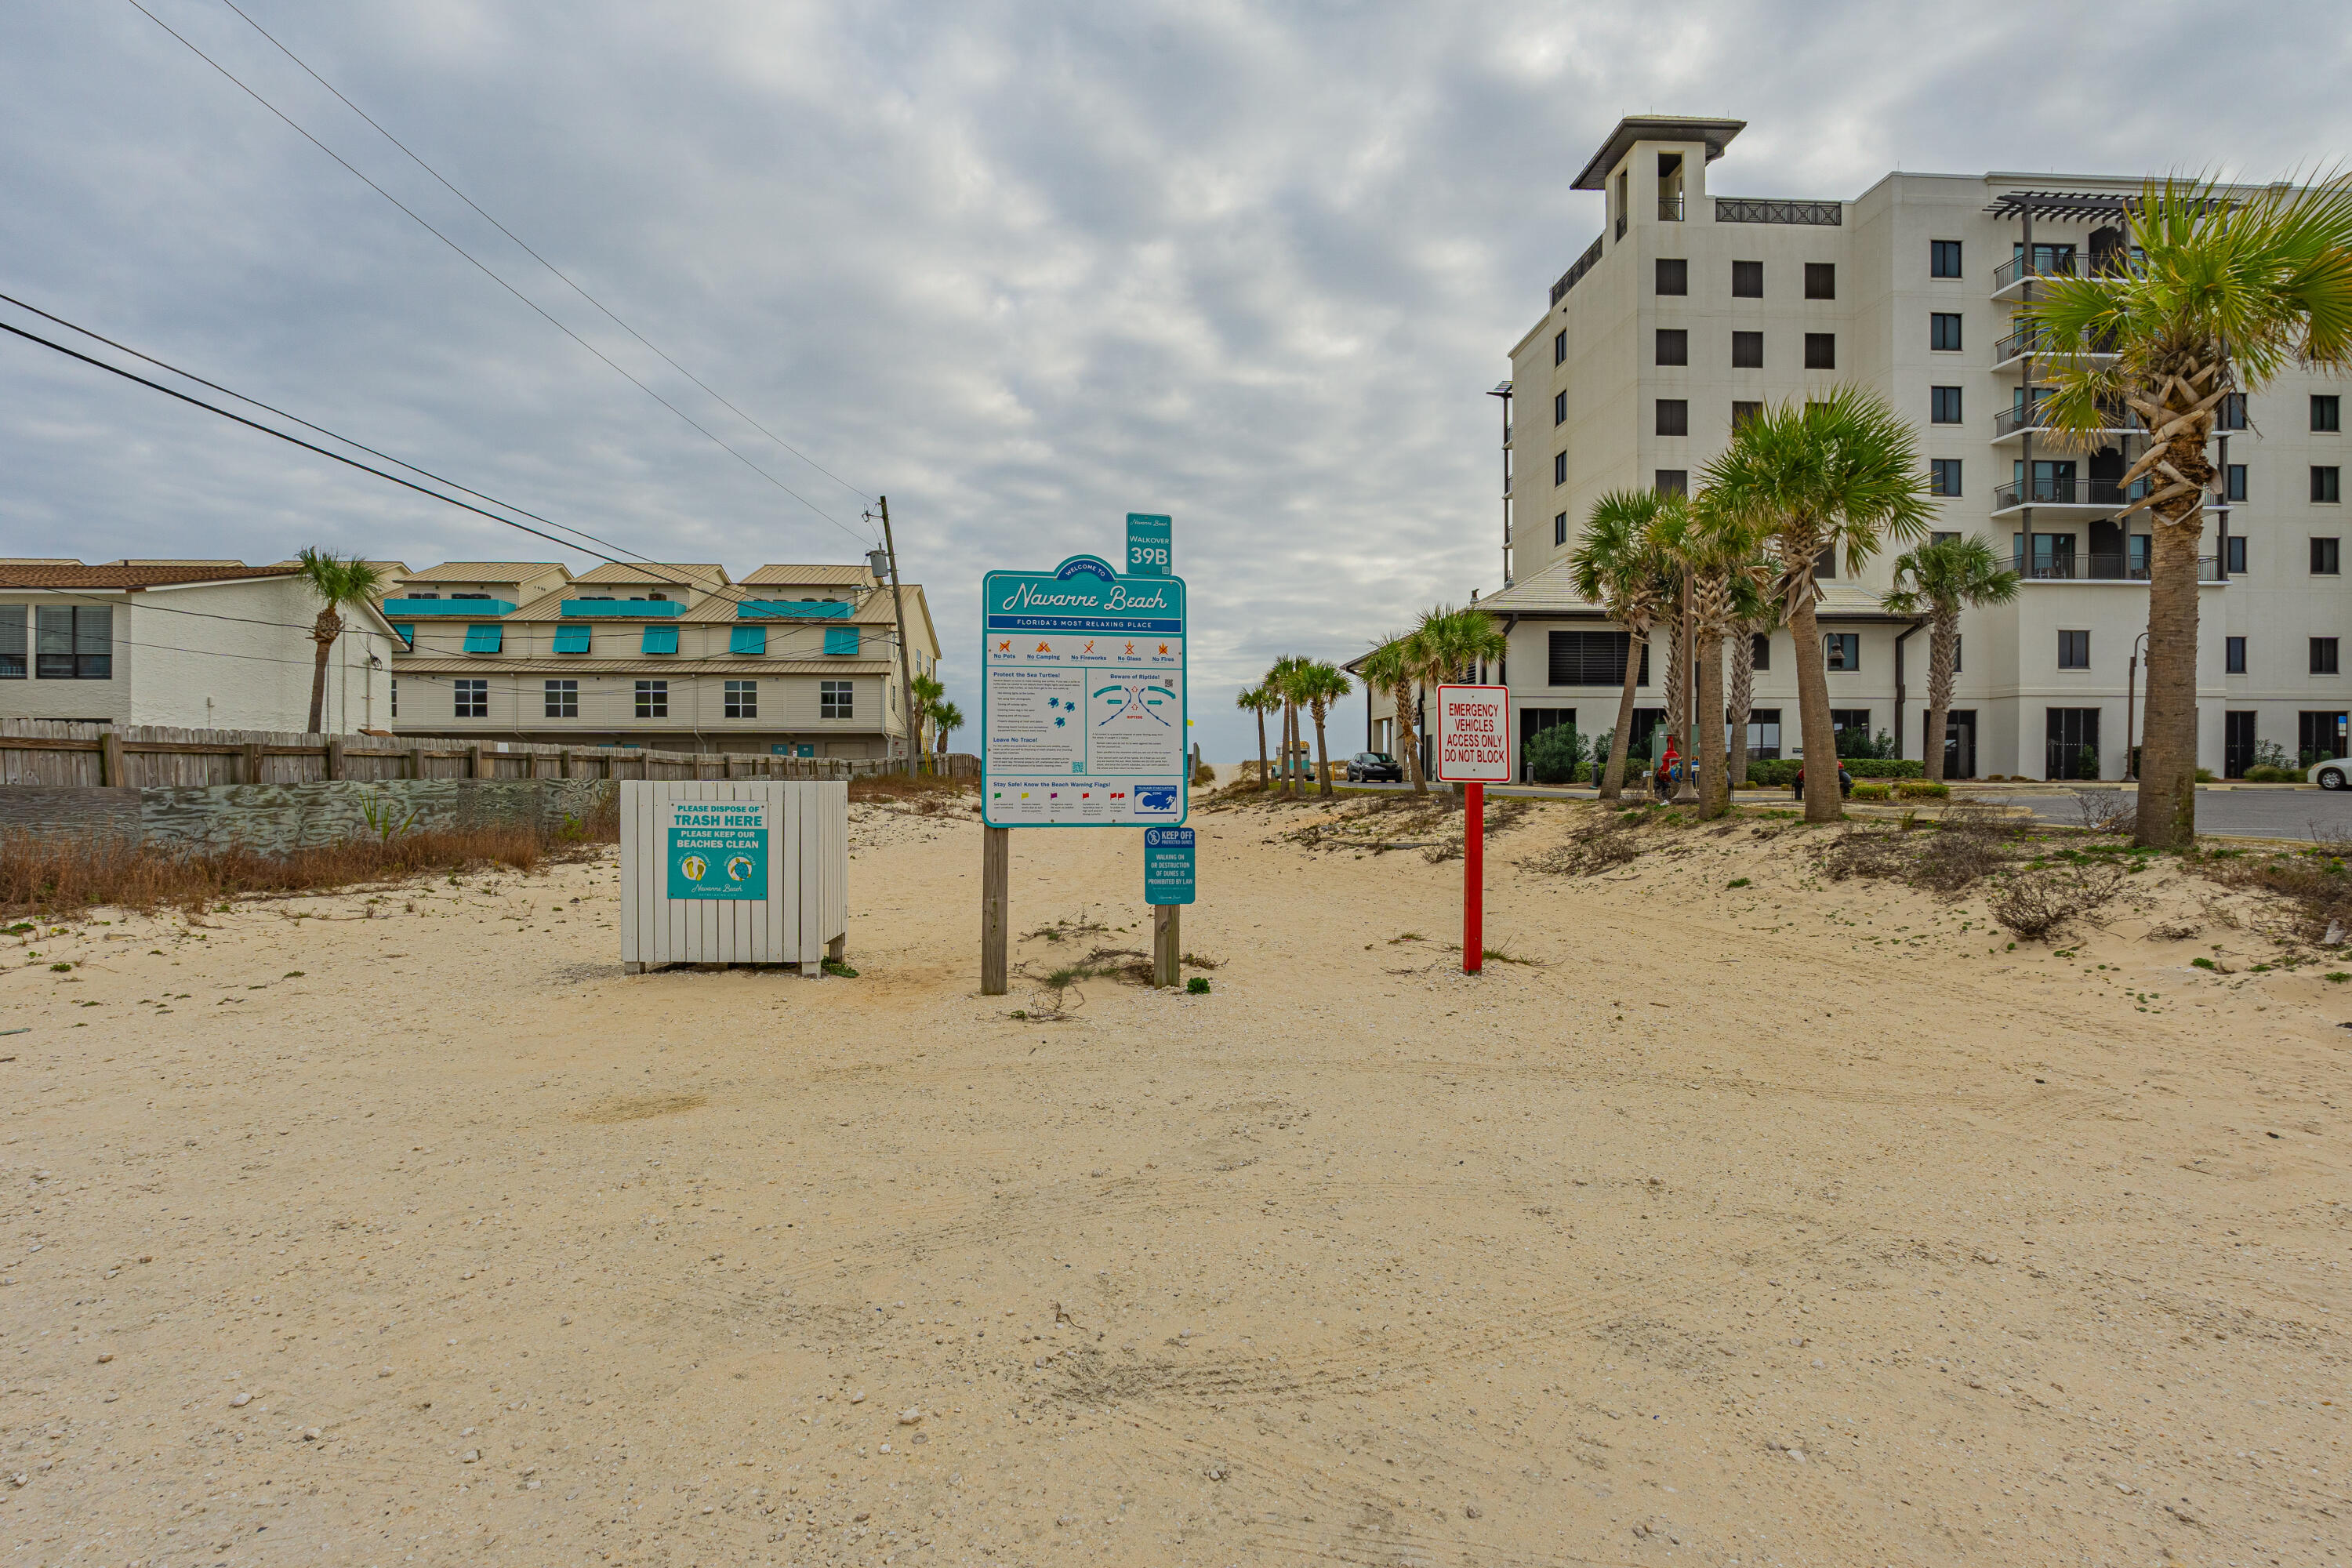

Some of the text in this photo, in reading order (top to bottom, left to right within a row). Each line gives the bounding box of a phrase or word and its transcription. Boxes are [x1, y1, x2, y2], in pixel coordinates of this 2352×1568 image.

[1131, 547, 1168, 565] 39B
[1065, 564, 1105, 577] WELCOME TO
[1002, 583, 1167, 611] Navarre Beach
[1449, 703, 1499, 717] EMERGENCY
[1455, 719, 1494, 732] VEHICLES
[1447, 734, 1502, 748] ACCESS ONLY
[1445, 749, 1505, 763] DO NOT BLOCK
[674, 815, 762, 827] TRASH HERE
[1161, 831, 1192, 839] KEEP OFF
[677, 839, 759, 848] BEACHES CLEAN
[722, 884, 743, 893] Beach
